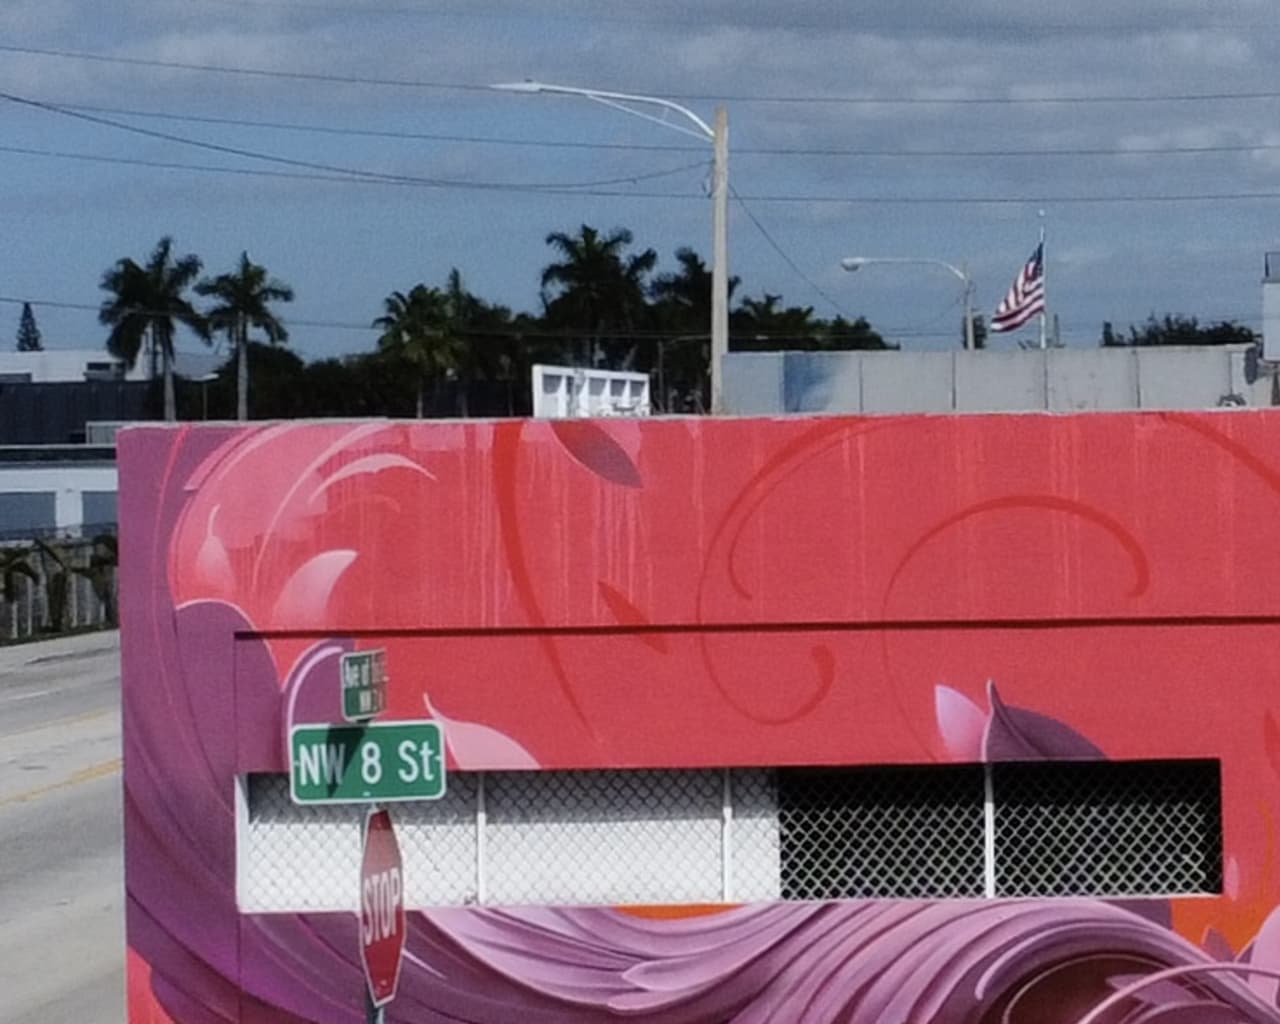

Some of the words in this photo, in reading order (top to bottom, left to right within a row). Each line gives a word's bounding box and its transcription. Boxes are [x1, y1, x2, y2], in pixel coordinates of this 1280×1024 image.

[299, 743, 345, 787] NW
[361, 741, 382, 784] 8
[398, 740, 434, 783] St
[363, 867, 401, 946] STOP
